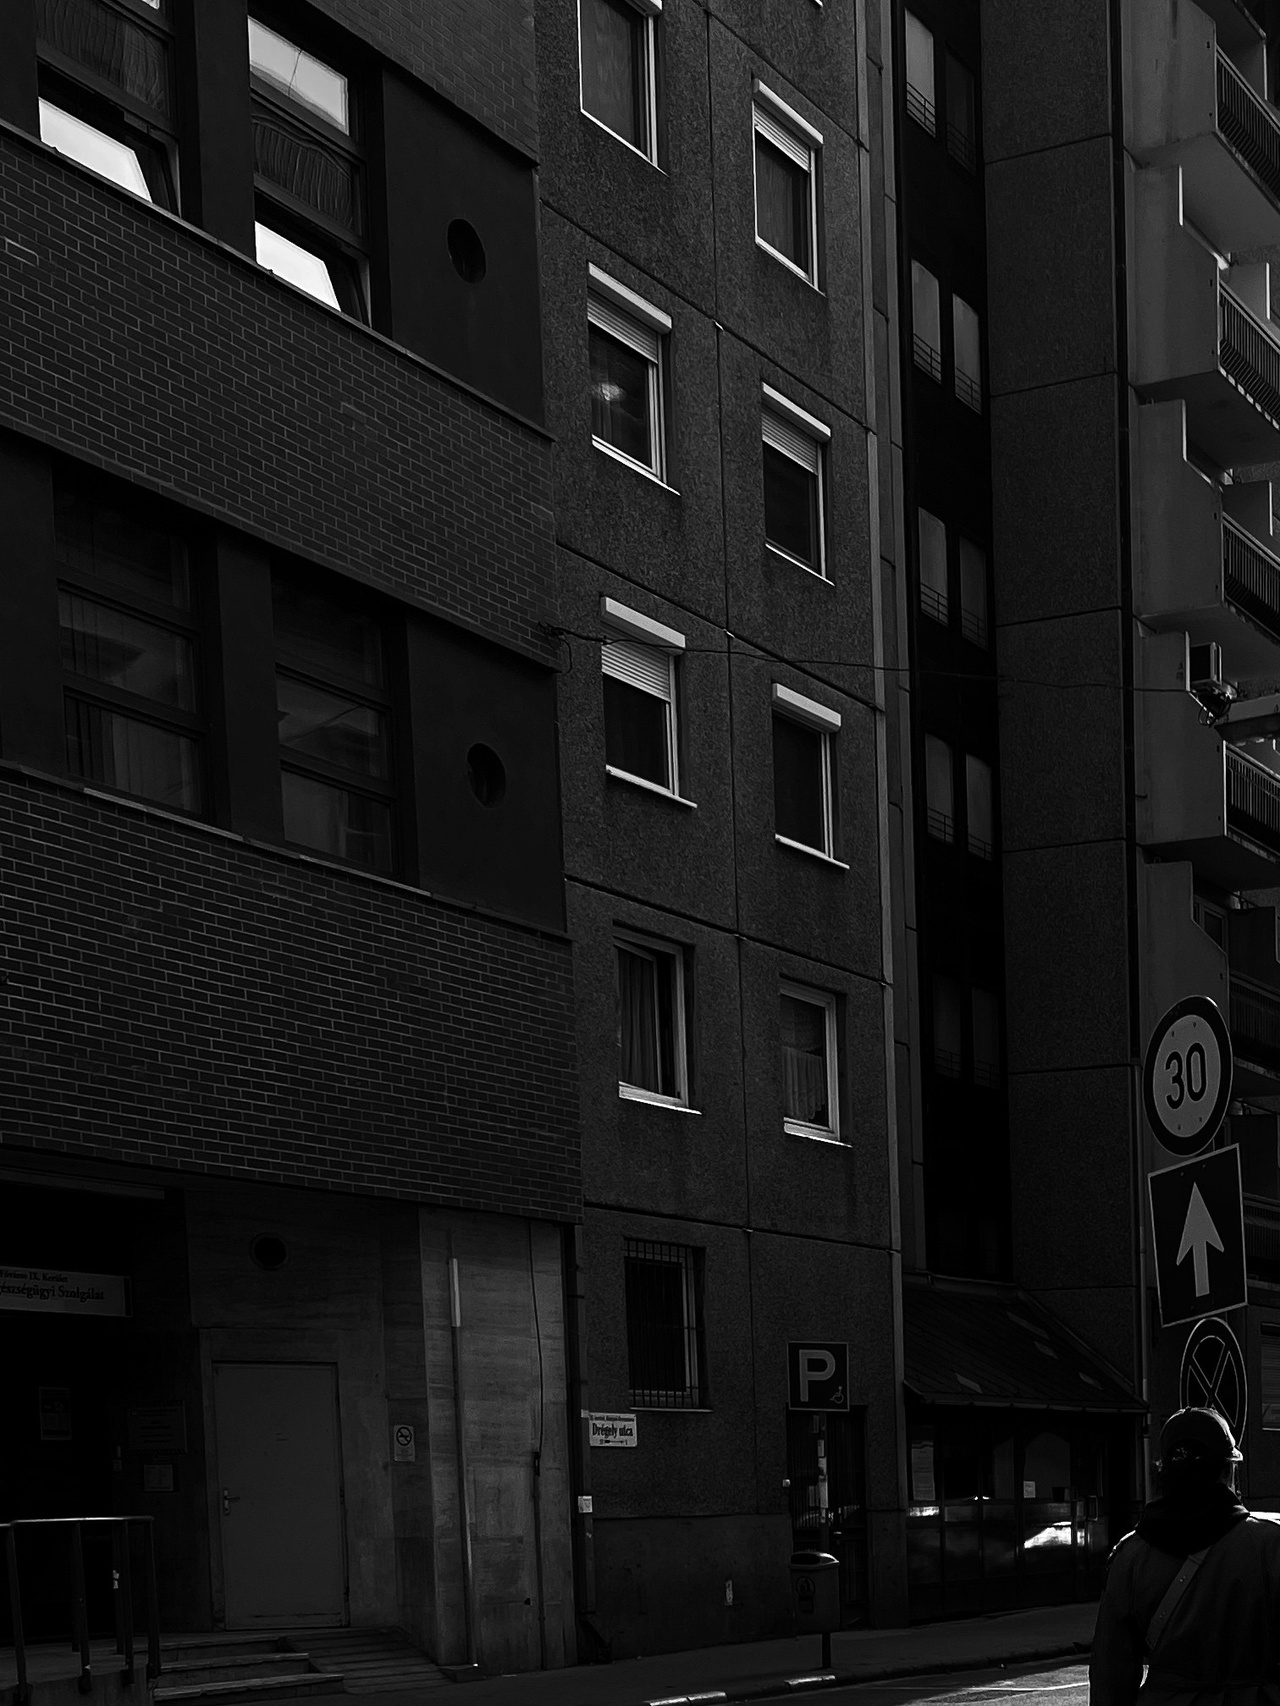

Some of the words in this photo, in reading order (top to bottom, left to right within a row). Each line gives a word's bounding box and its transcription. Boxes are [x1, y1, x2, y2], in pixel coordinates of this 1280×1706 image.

[1165, 1042, 1207, 1109] 30
[0, 1281, 55, 1300] észségügyi
[58, 1286, 104, 1303] Szolgálat
[799, 1349, 836, 1402] P
[619, 1424, 633, 1436] utca
